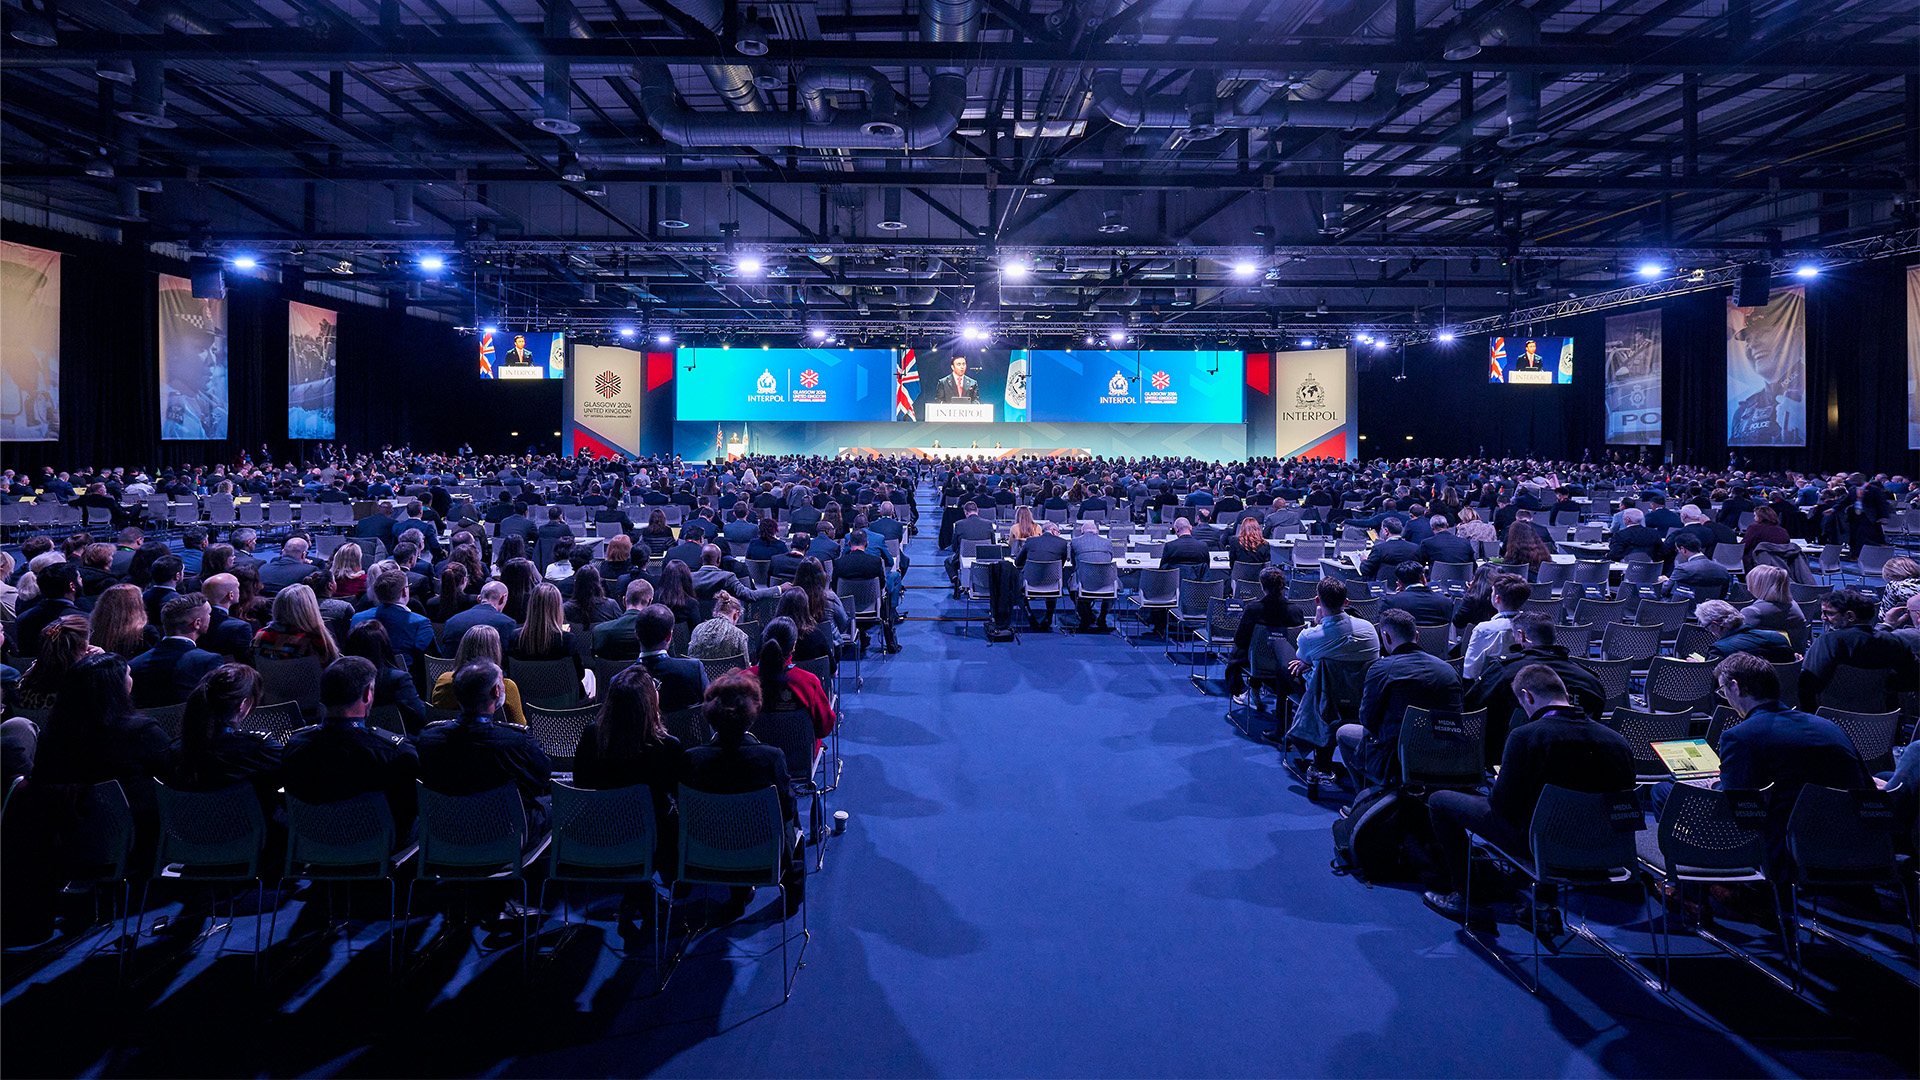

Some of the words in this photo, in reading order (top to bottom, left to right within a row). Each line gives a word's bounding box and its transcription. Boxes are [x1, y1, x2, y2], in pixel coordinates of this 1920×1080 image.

[1780, 371, 1799, 387] POLICE
[936, 409, 983, 417] INTERPOL
[1282, 411, 1338, 421] INTERPOL
[1622, 412, 1661, 426] PO
[1749, 420, 1771, 431] POLICE
[1434, 725, 1462, 733] RESERVED
[1613, 803, 1633, 811] MEDIA
[1610, 811, 1641, 820] RESERVED
